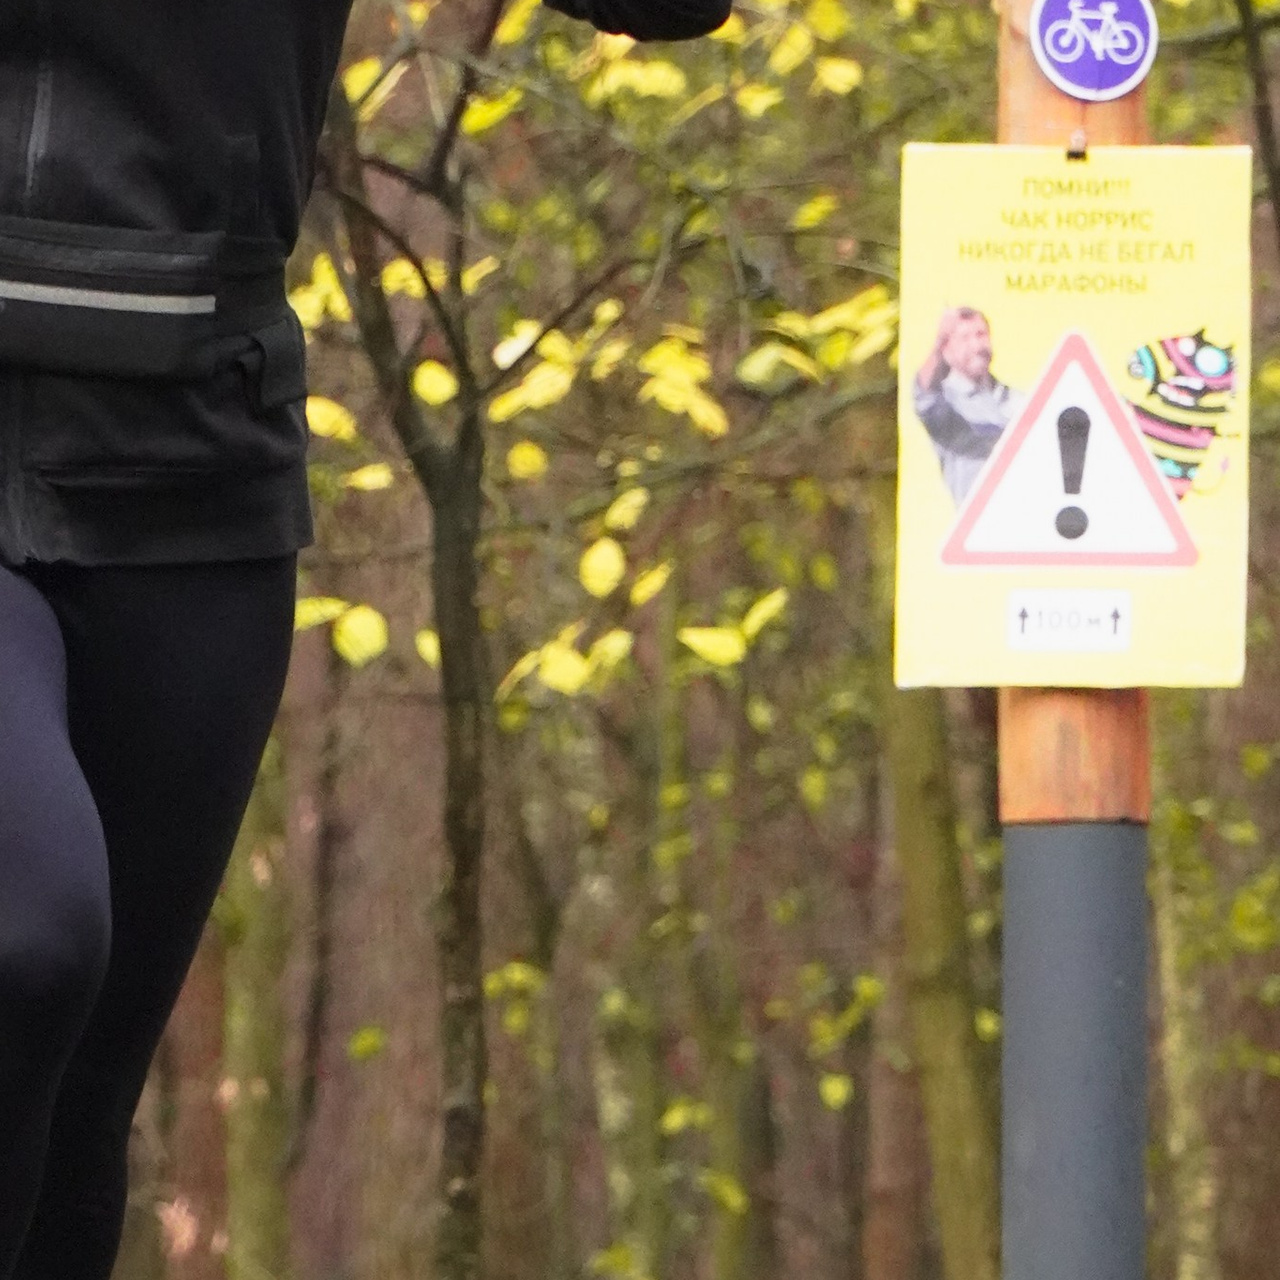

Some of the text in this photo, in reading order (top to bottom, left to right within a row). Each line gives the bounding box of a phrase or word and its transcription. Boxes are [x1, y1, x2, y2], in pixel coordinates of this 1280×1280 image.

[1001, 210, 1154, 231] ЧАК НОРРИС
[958, 241, 1195, 263] НИКОГДА НЕ БЕГАЛ
[1005, 273, 1147, 293] МАРАФОНЫ
